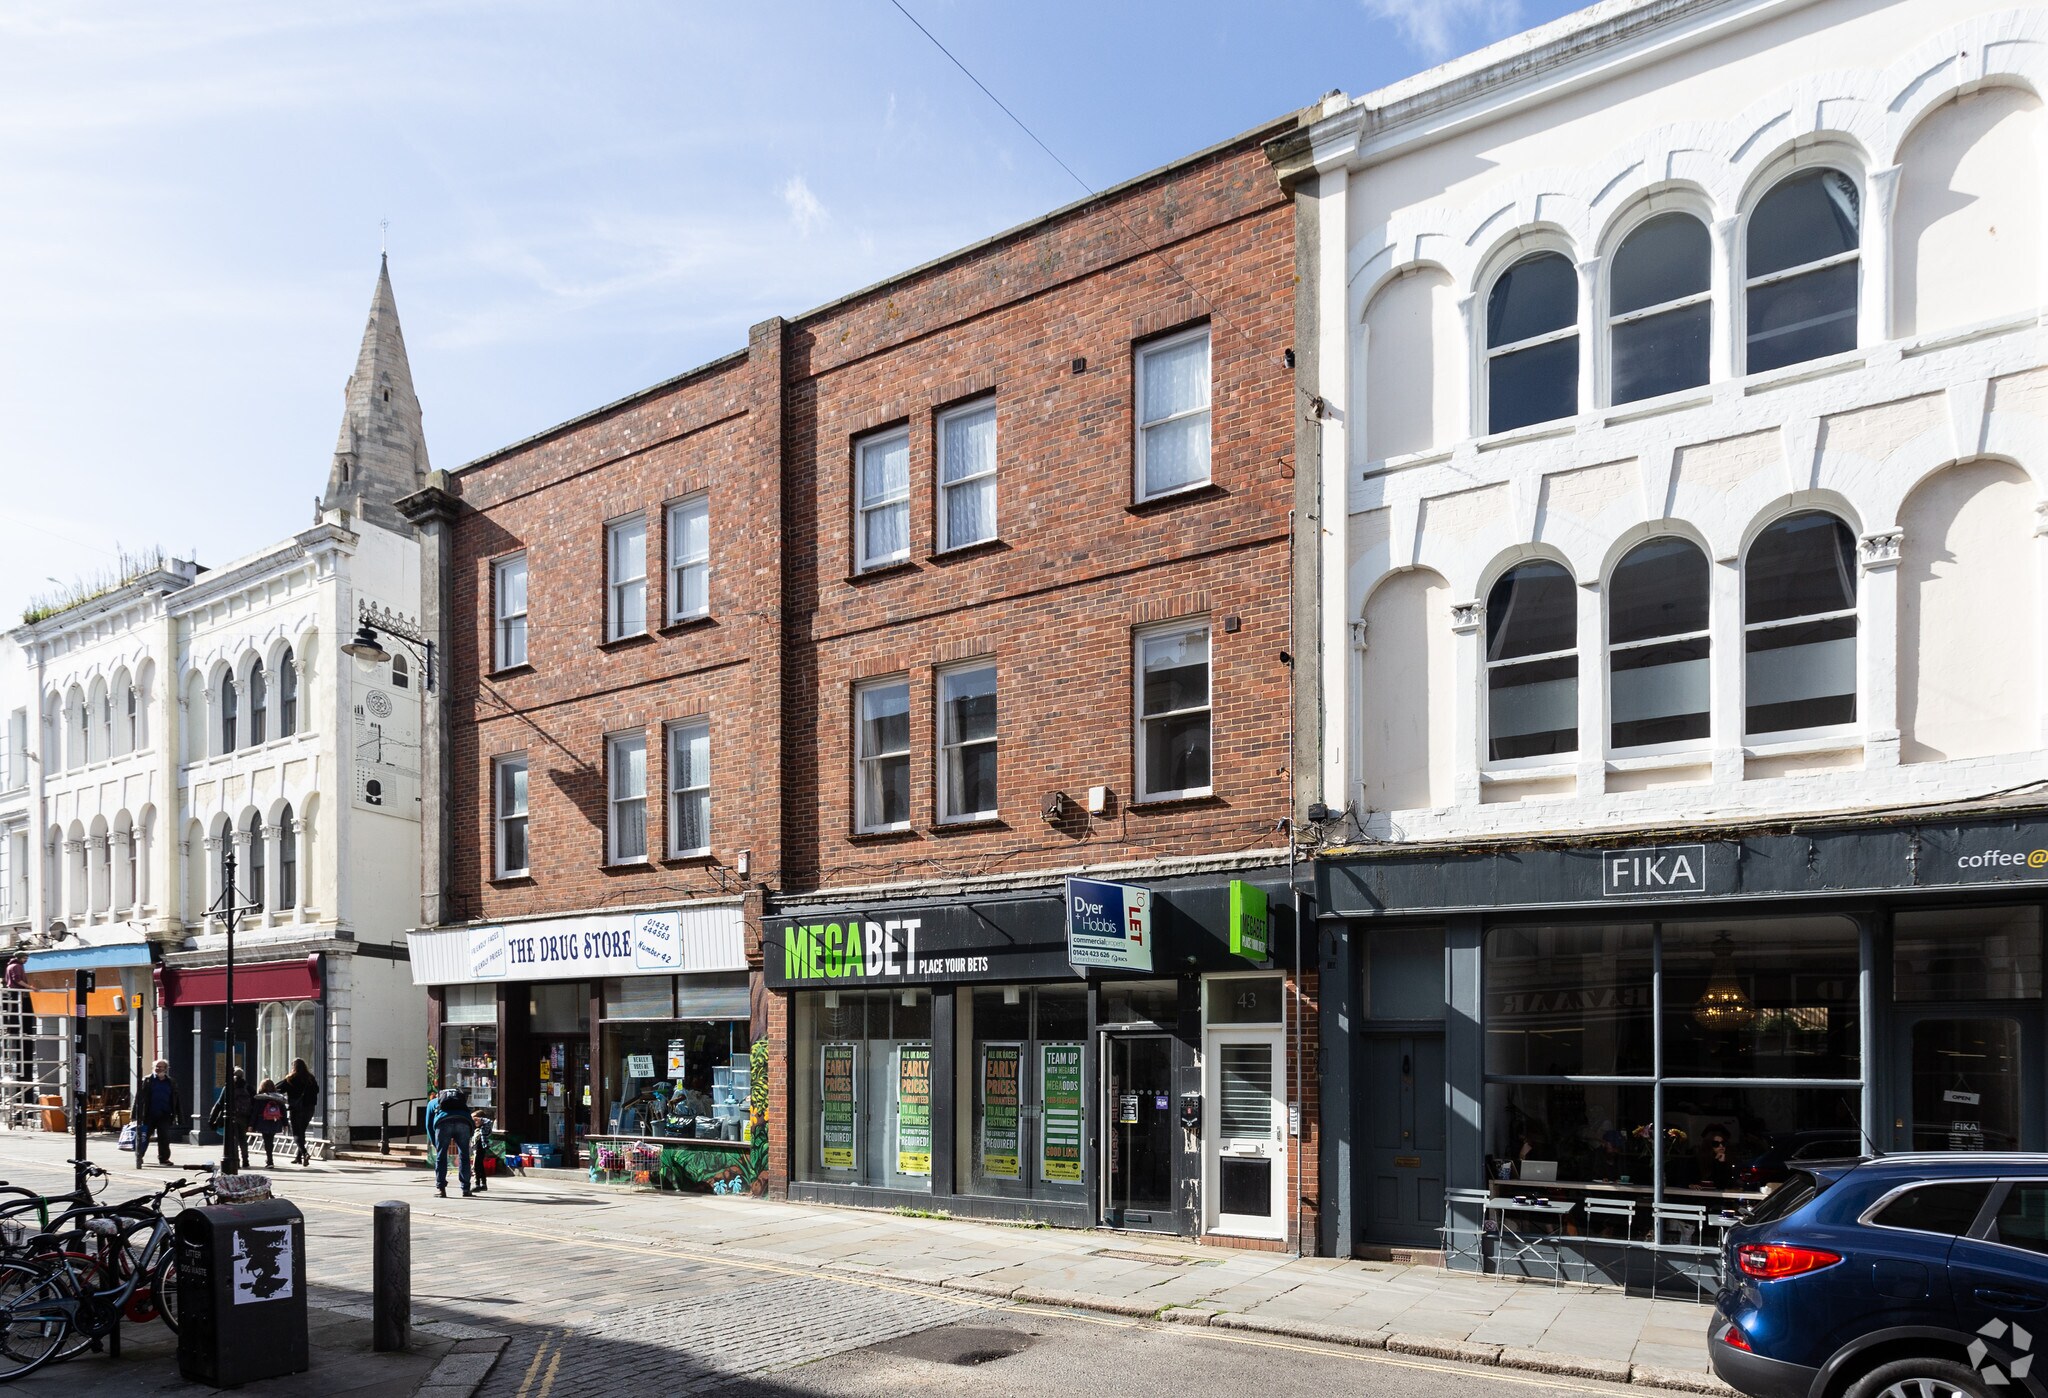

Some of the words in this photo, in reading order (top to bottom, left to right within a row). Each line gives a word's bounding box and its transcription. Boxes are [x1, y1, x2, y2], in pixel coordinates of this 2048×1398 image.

[1613, 855, 1696, 887] FIKA
[1074, 896, 1103, 916] Dyer
[647, 918, 670, 931] 01424
[1082, 917, 1117, 933] Hobbis
[1128, 907, 1143, 946] LET
[1242, 912, 1266, 939] MEGABET
[642, 925, 670, 941] 444563
[509, 938, 535, 964] THE
[540, 934, 578, 962] DRUG
[584, 930, 631, 959] STORE
[638, 940, 661, 958] Number
[661, 955, 672, 964] 42
[785, 918, 921, 979] MEGABET
[1073, 949, 1088, 957] 01424
[1089, 950, 1099, 958] 423
[1100, 951, 1110, 959] 626
[919, 958, 944, 974] PLACE
[945, 957, 966, 973] YOUR
[968, 956, 988, 972] BETS
[1237, 992, 1256, 1009] 43
[1047, 1052, 1066, 1065] TEAM
[1068, 1053, 1078, 1065] UP
[826, 1060, 851, 1076] EARLY
[902, 1061, 929, 1077] EARLY
[987, 1061, 1017, 1078] EARLY
[1058, 1067, 1078, 1075] MEGABET
[826, 1078, 851, 1092] PRICES
[901, 1079, 929, 1093] PRICES
[986, 1080, 1017, 1095] PRICES
[1046, 1081, 1078, 1091] MEGAODDS
[826, 1103, 832, 1111] TO
[841, 1103, 851, 1111] OUR
[902, 1105, 908, 1114] TO
[909, 1105, 917, 1114] ALL
[918, 1105, 929, 1114] OUR
[987, 1107, 994, 1116] TO
[995, 1107, 1003, 1116] ALL
[1005, 1107, 1016, 1116] OUR
[826, 1113, 851, 1122] CUSTOMERS
[901, 1117, 929, 1125] CUSTOMERS
[987, 1118, 1016, 1127] CUSTOMERS
[1954, 1122, 1977, 1131] FIKA
[825, 1132, 851, 1143] REQUIRED!
[901, 1136, 929, 1147] REQUIRED!
[986, 1138, 1016, 1149] REQUIRED!
[1046, 1146, 1061, 1157] GOOD
[1063, 1147, 1078, 1158] LUCK
[185, 1249, 202, 1259] LITTER
[181, 1264, 191, 1273] DOG
[192, 1267, 207, 1276] WASTE
